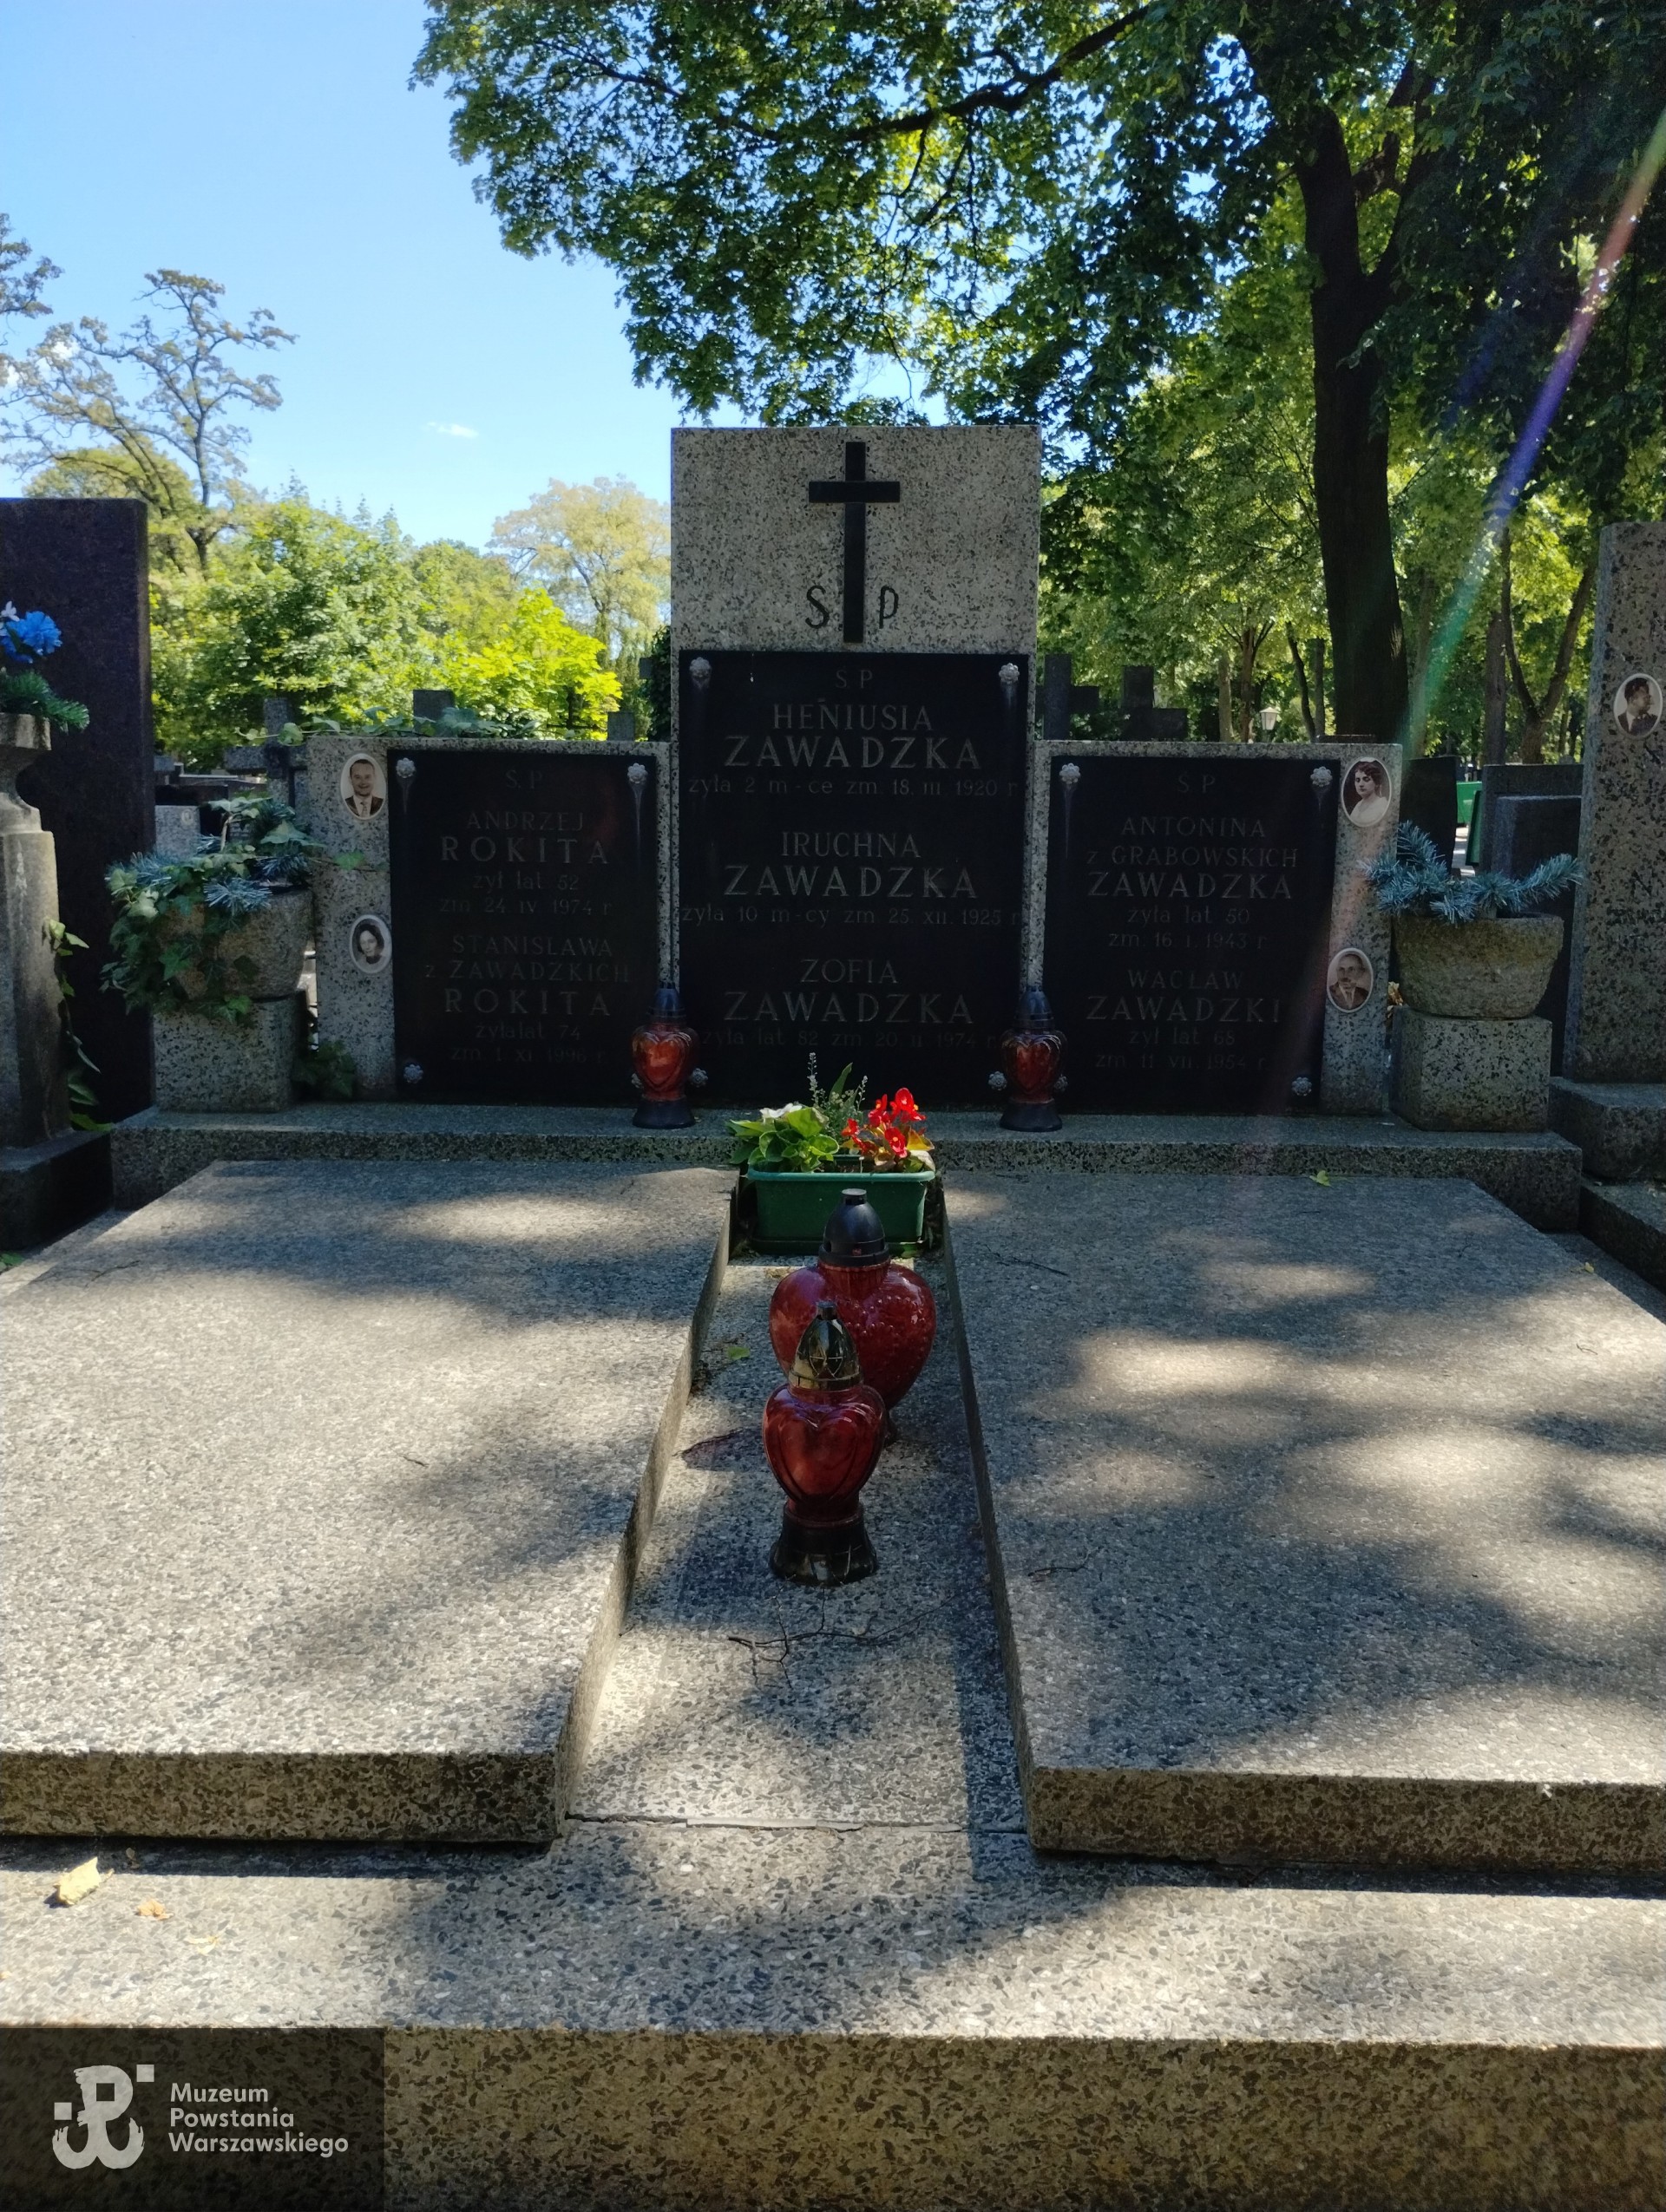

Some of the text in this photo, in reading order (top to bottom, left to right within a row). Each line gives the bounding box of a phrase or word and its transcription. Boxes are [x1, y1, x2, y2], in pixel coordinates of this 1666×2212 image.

[878, 585, 899, 630] P
[724, 736, 981, 770] ZAWADZKA
[745, 777, 757, 794] 2
[954, 780, 999, 796] 1920
[1201, 773, 1217, 794] P
[467, 811, 584, 832] ANDRZEJ
[1119, 815, 1266, 838] ANTONINA
[440, 835, 608, 865] ROKITA
[781, 831, 922, 859] IRUCHNA
[1111, 844, 1299, 867] GRABOWSKICH
[516, 870, 541, 889] lat
[557, 874, 580, 891] 52
[724, 866, 978, 899] ZAWADZKA
[1087, 870, 1292, 900] ZAWADZKA
[552, 898, 592, 916] 1974
[961, 909, 1002, 926] 1925
[1184, 904, 1215, 924] lat
[1225, 907, 1250, 924] 50
[449, 959, 629, 984] ZAWADZKICH
[800, 959, 898, 984] ZOFIA
[443, 987, 611, 1017] ROKITA
[724, 991, 974, 1024] ZAWADZKA
[1086, 995, 1281, 1024] ZAWADZKI
[558, 1024, 580, 1042] 74
[1172, 1026, 1200, 1045] lat
